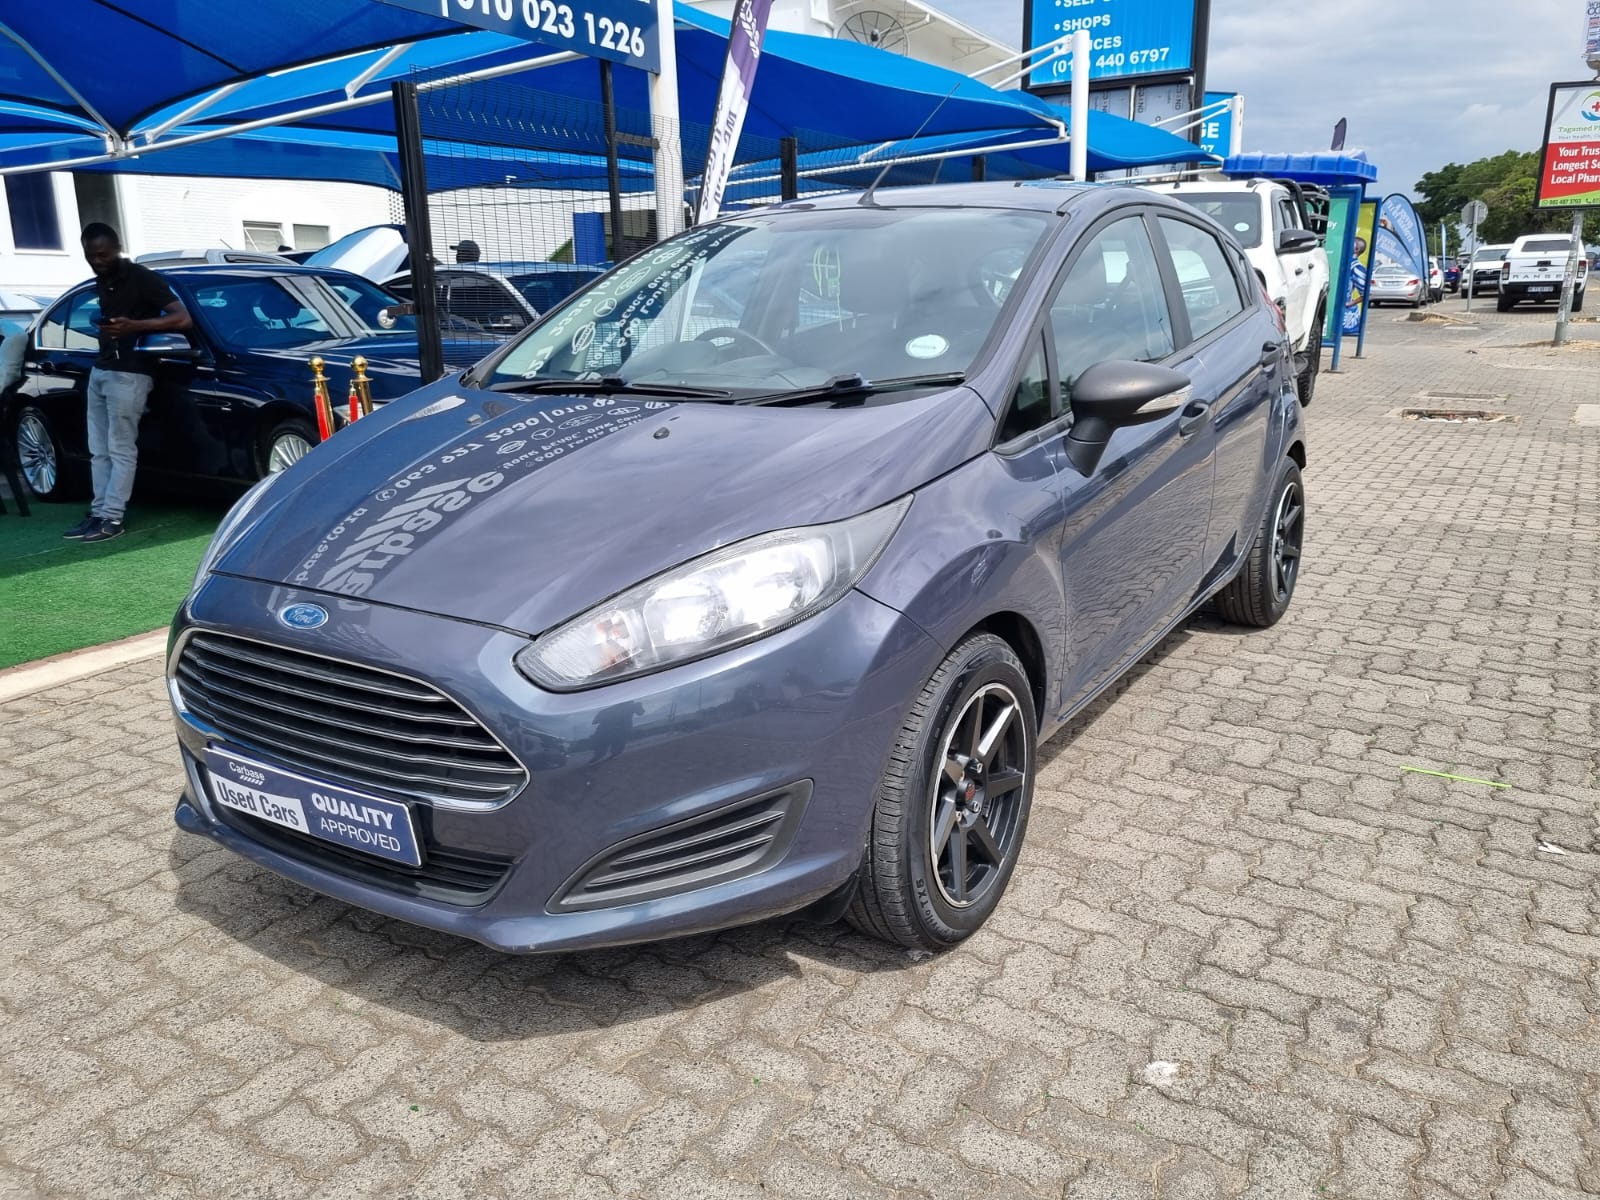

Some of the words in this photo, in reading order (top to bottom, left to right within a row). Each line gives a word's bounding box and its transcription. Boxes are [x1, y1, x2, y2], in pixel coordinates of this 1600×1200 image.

[522, 0, 575, 39] 023
[584, 12, 646, 58] 1226
[1062, 14, 1111, 32] SHOPS
[1096, 53, 1125, 69] 440
[1130, 47, 1170, 65] 6797
[1559, 146, 1579, 157] Your
[1553, 159, 1589, 173] Longest
[1551, 174, 1576, 185] Local
[228, 761, 265, 782] Carbase
[216, 779, 258, 812] Used
[259, 799, 299, 827] Cars
[311, 792, 394, 830] QUALITY
[320, 817, 401, 853] APPROVED
